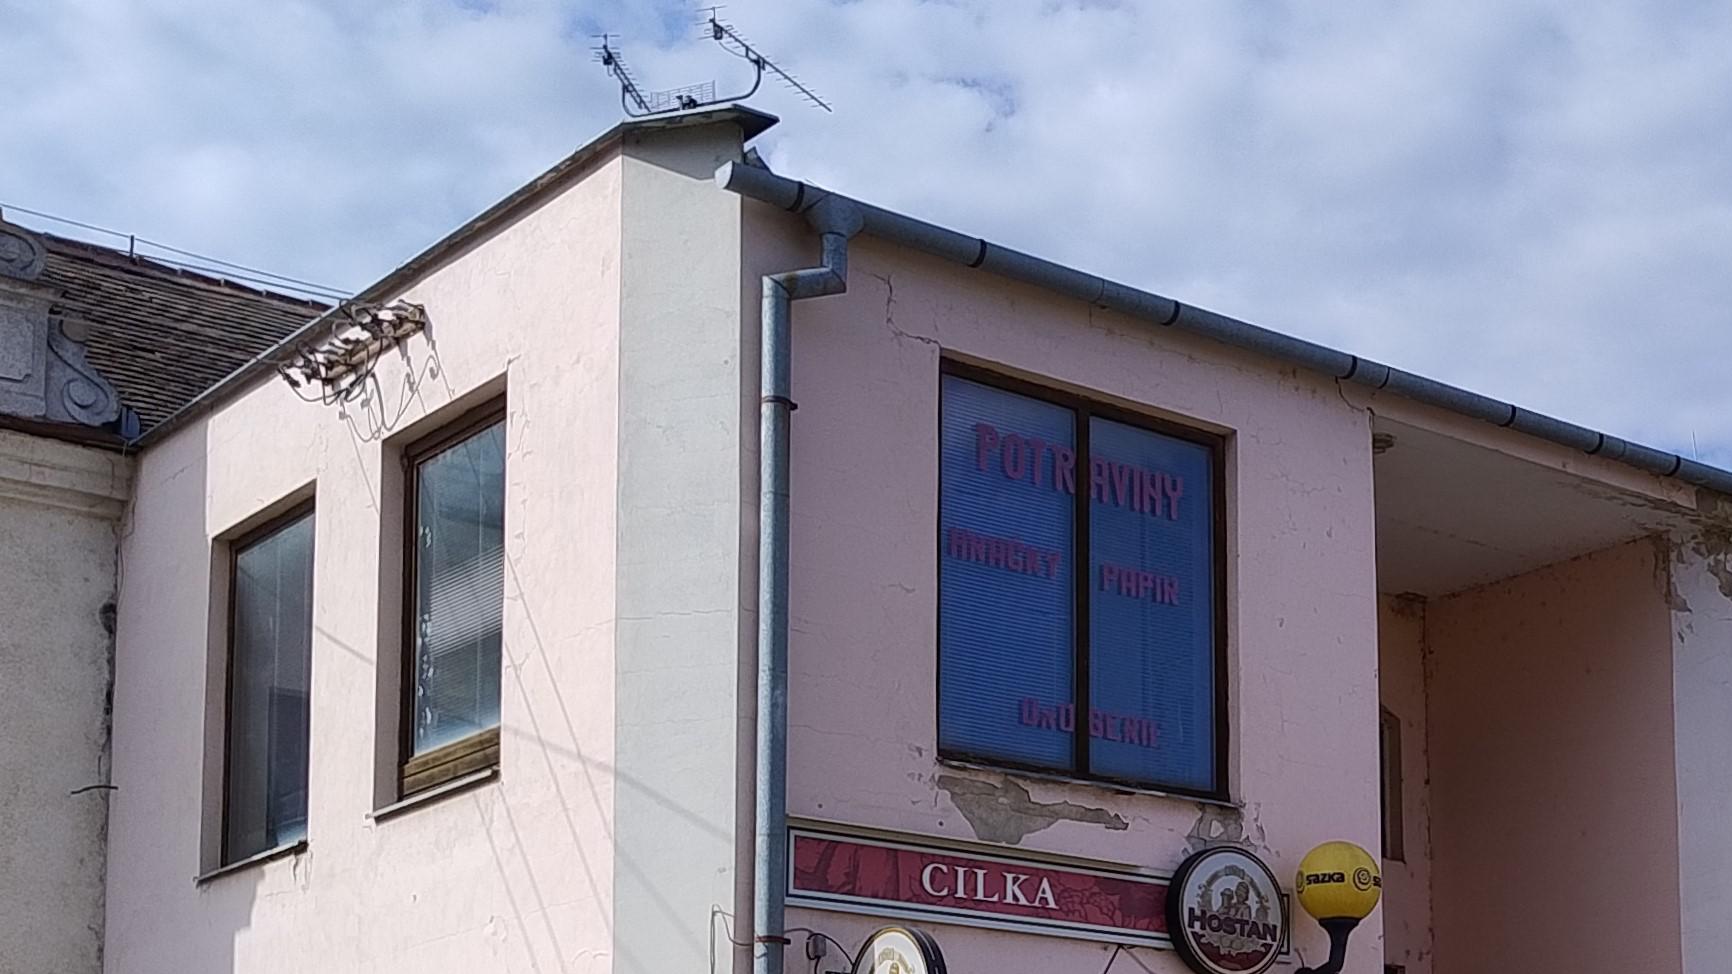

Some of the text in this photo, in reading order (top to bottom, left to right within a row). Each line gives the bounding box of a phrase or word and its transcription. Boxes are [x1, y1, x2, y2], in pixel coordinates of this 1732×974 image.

[975, 422, 1185, 521] POTRAVINY
[920, 862, 1060, 911] CILKA
[1187, 906, 1278, 943] HOSTAN
